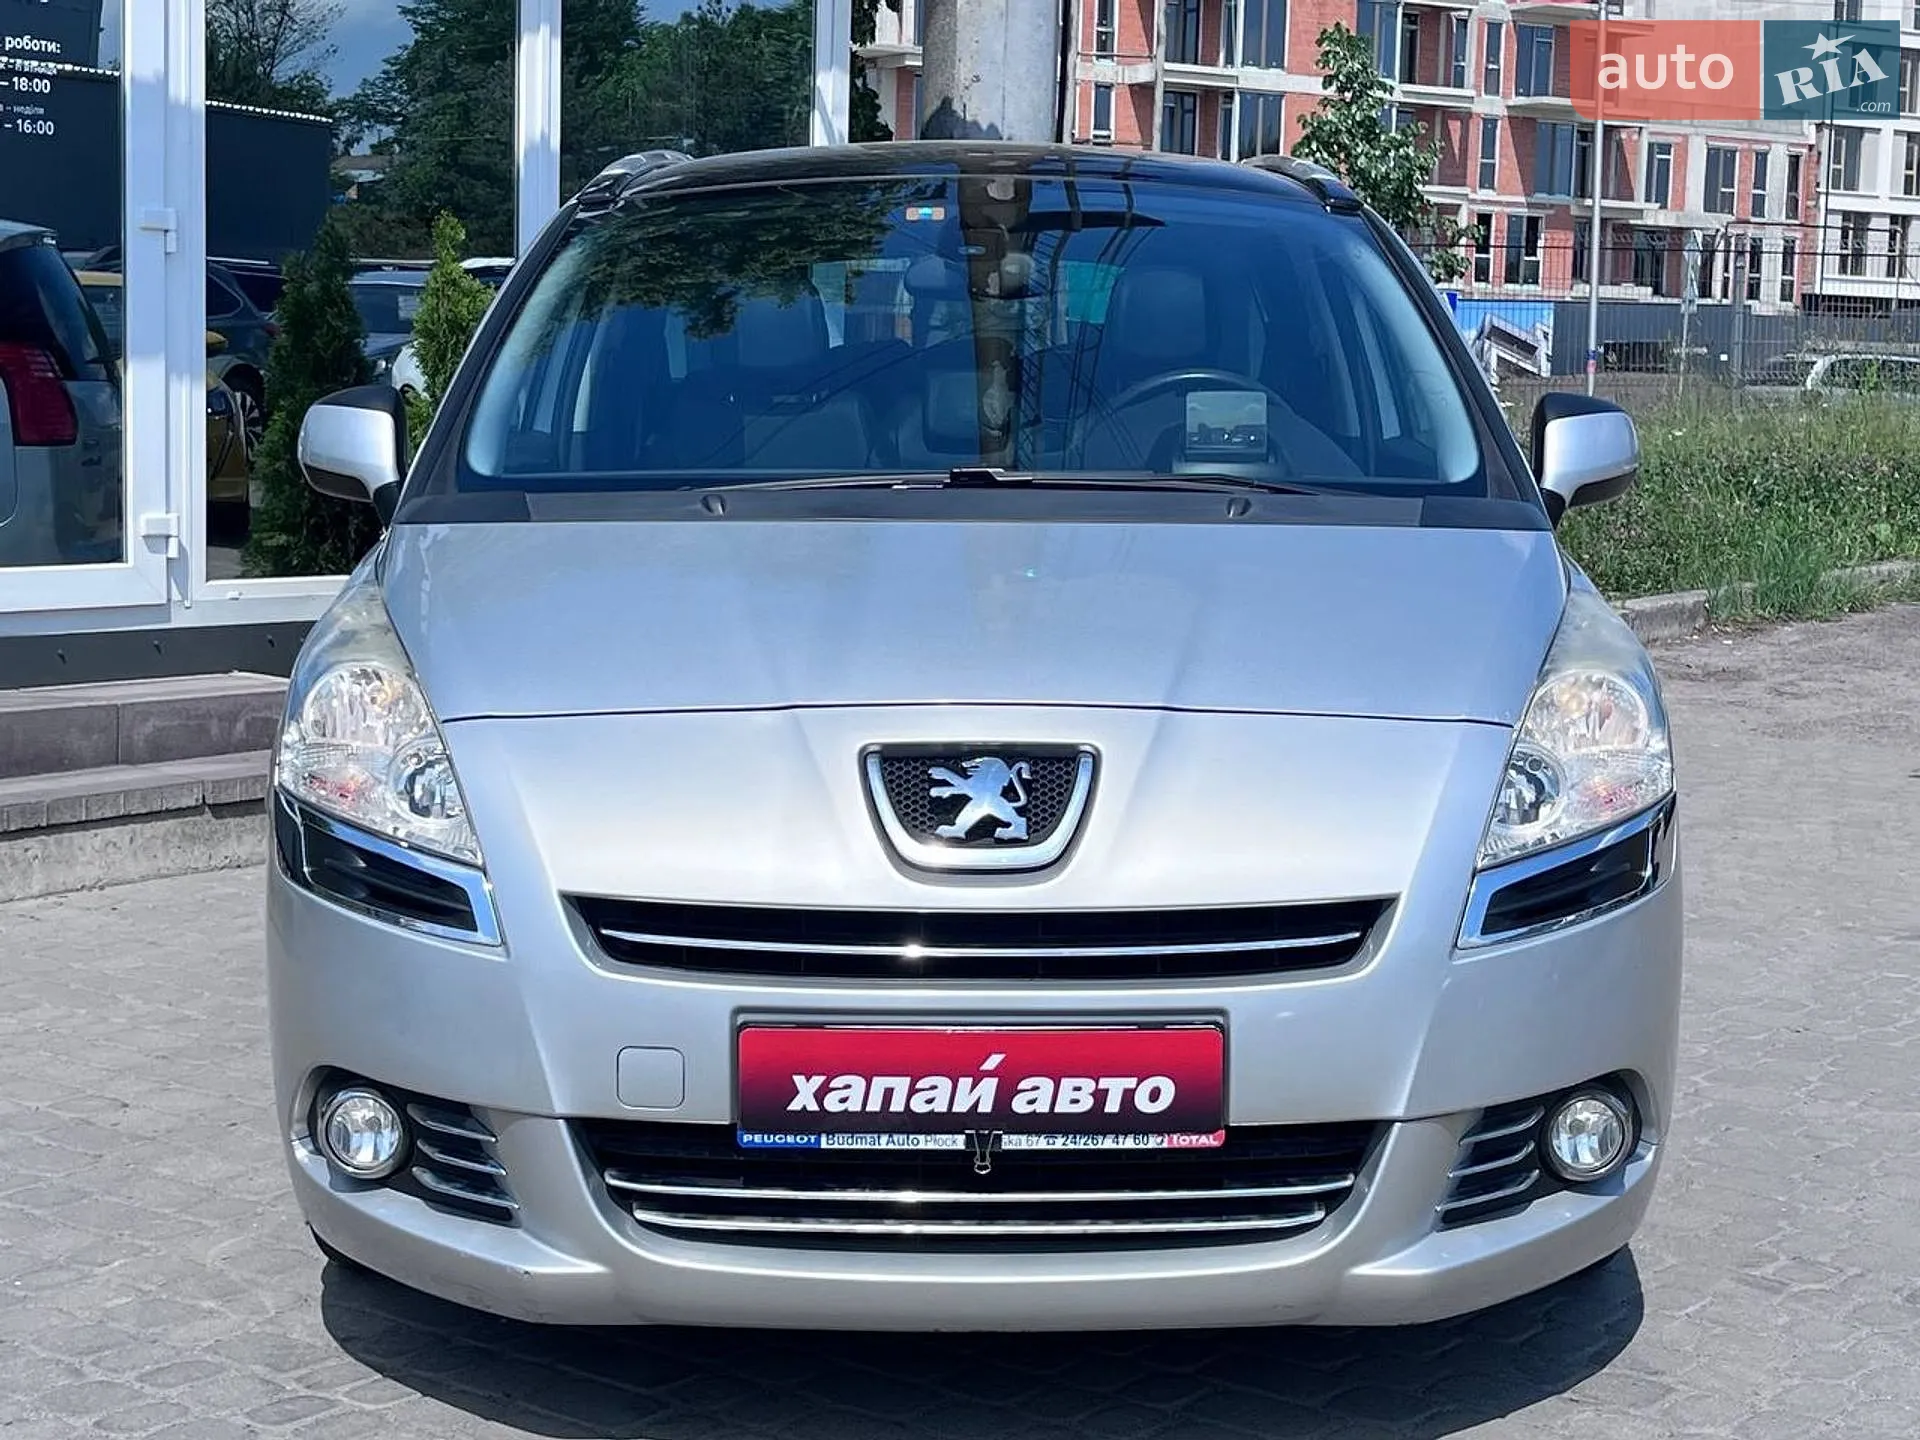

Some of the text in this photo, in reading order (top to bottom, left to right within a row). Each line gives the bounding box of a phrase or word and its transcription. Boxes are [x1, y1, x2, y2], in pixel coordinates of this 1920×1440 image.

[5, 35, 61, 54] роботи:
[12, 76, 51, 94] 18:00
[16, 118, 55, 136] 16:00
[1011, 1075, 1176, 1114] авто
[742, 1134, 817, 1144] PEUGEOT
[826, 1132, 882, 1146] Budmat
[885, 1133, 921, 1147] Auto
[1173, 1133, 1218, 1145] TOTAL
